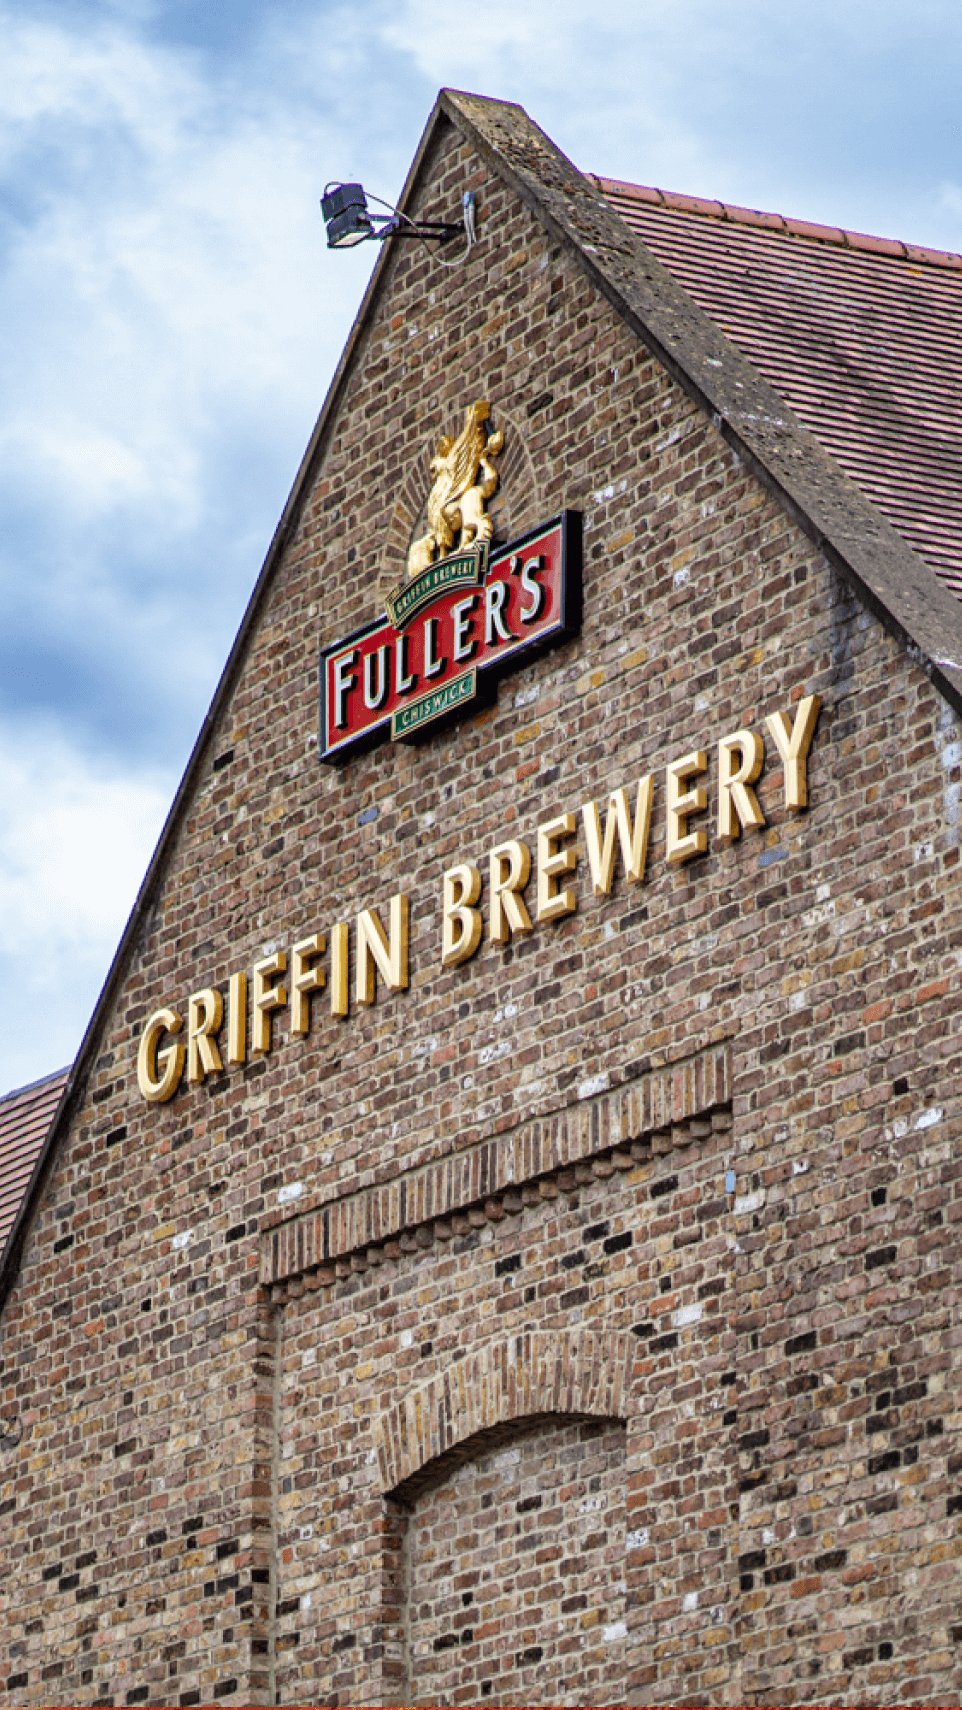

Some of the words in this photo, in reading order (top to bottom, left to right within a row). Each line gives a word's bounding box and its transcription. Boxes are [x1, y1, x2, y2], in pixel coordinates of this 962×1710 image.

[333, 555, 546, 730] FULLER'S
[402, 679, 467, 727] CHISWICK
[137, 893, 410, 1103] GRIFFIN
[441, 694, 822, 968] BREWERY
